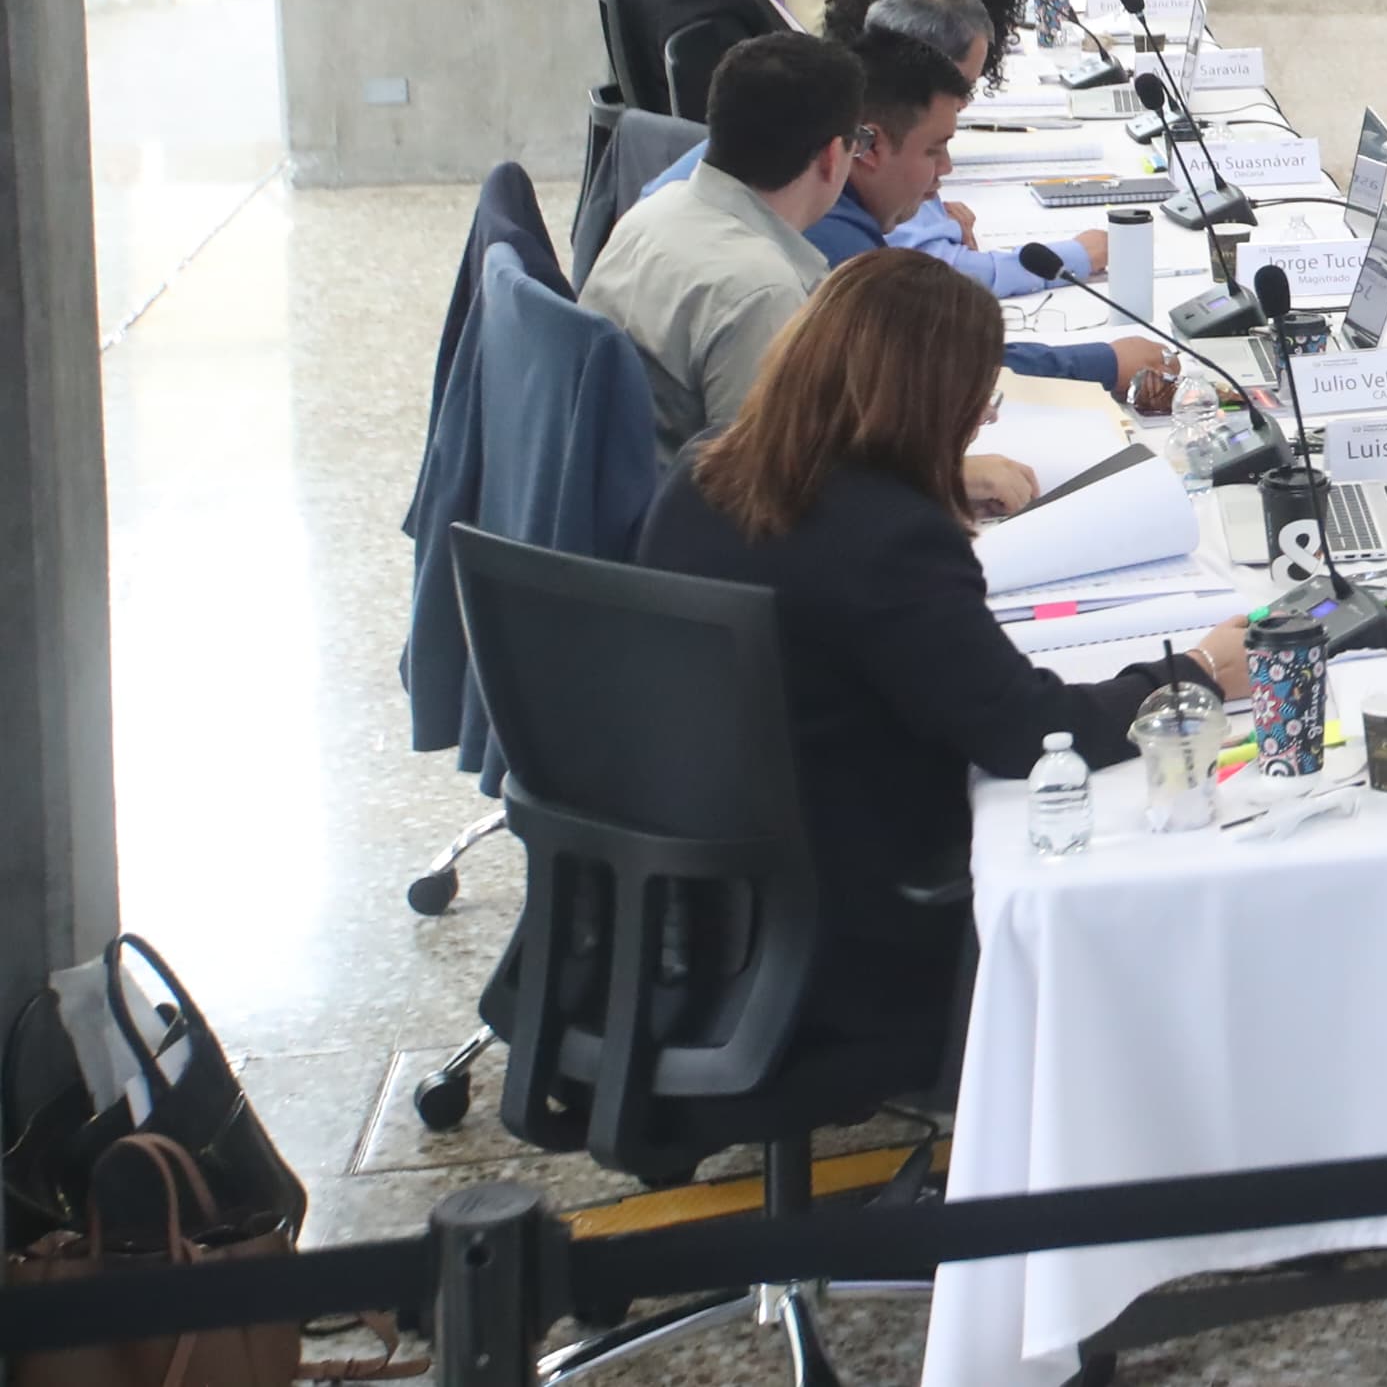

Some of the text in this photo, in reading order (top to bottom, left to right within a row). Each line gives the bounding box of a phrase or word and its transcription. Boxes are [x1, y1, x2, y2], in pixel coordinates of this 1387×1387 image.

[1200, 64, 1250, 77] Saravia
[1225, 154, 1307, 170] Suasnávar
[1298, 274, 1350, 286] Magistrado
[1312, 376, 1357, 394] Julio
